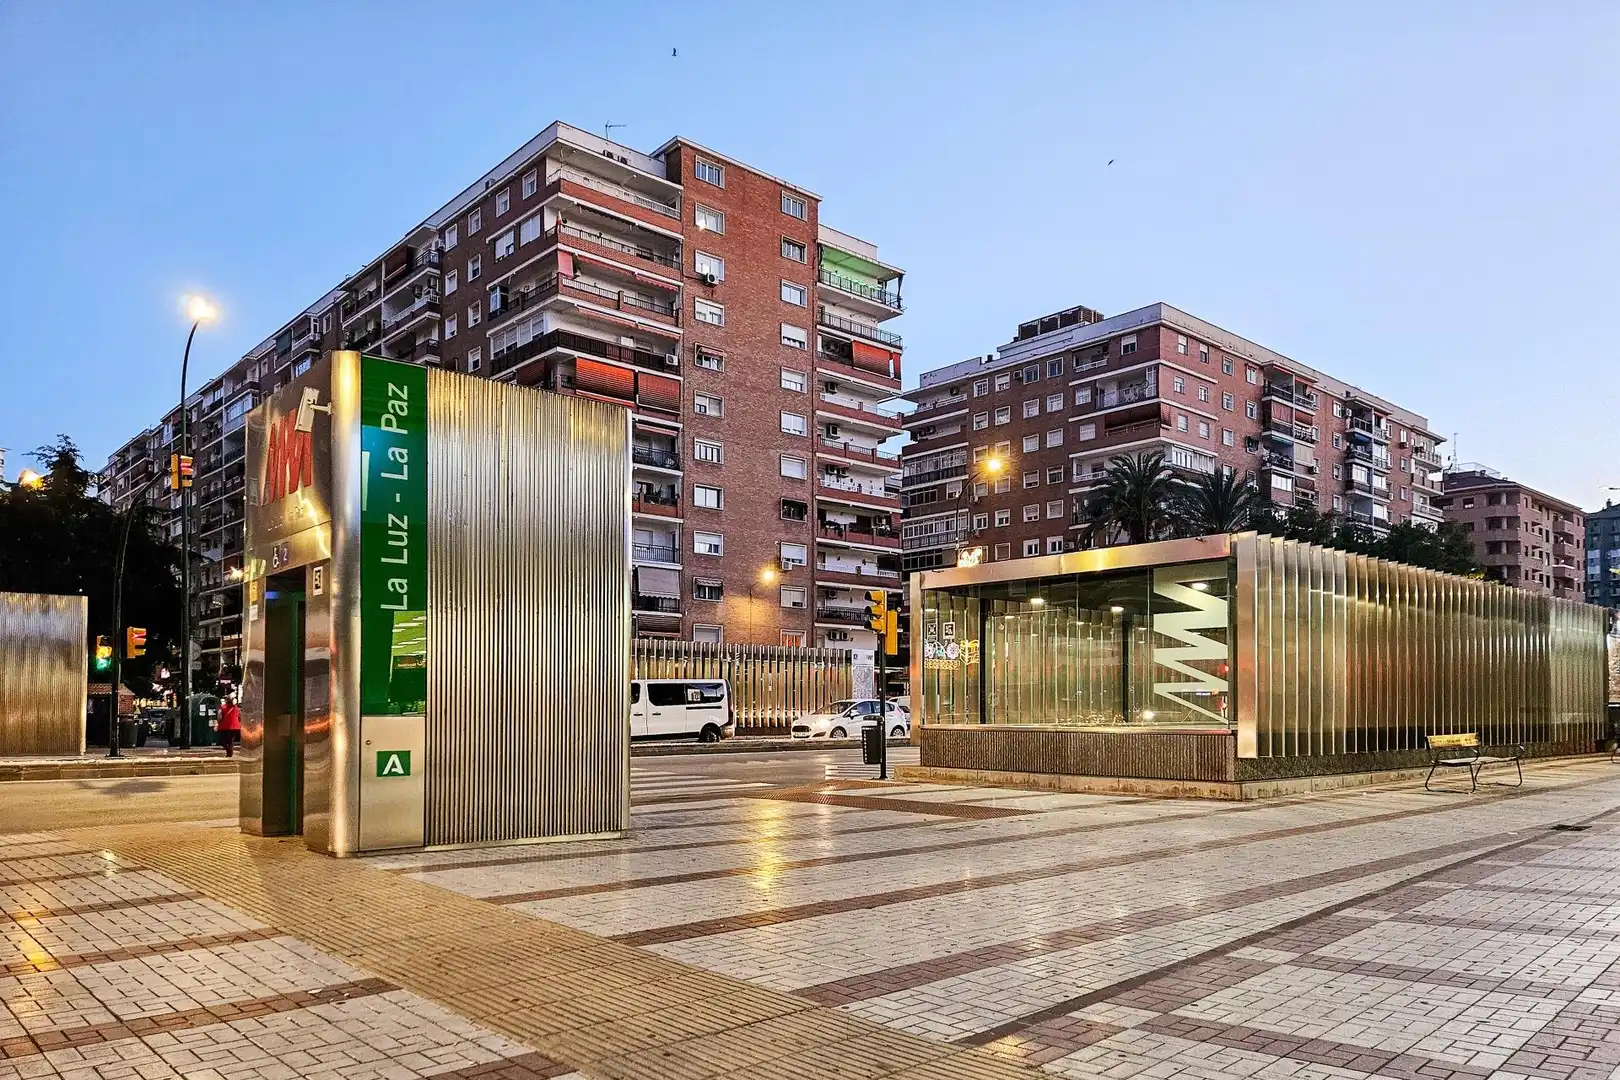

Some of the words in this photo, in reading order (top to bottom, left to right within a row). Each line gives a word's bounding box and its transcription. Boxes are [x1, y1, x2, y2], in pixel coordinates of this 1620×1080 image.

[380, 382, 408, 434] Paz
[380, 446, 408, 480] La
[380, 513, 408, 564] Luz
[380, 578, 408, 610] La
[382, 753, 405, 775] A
